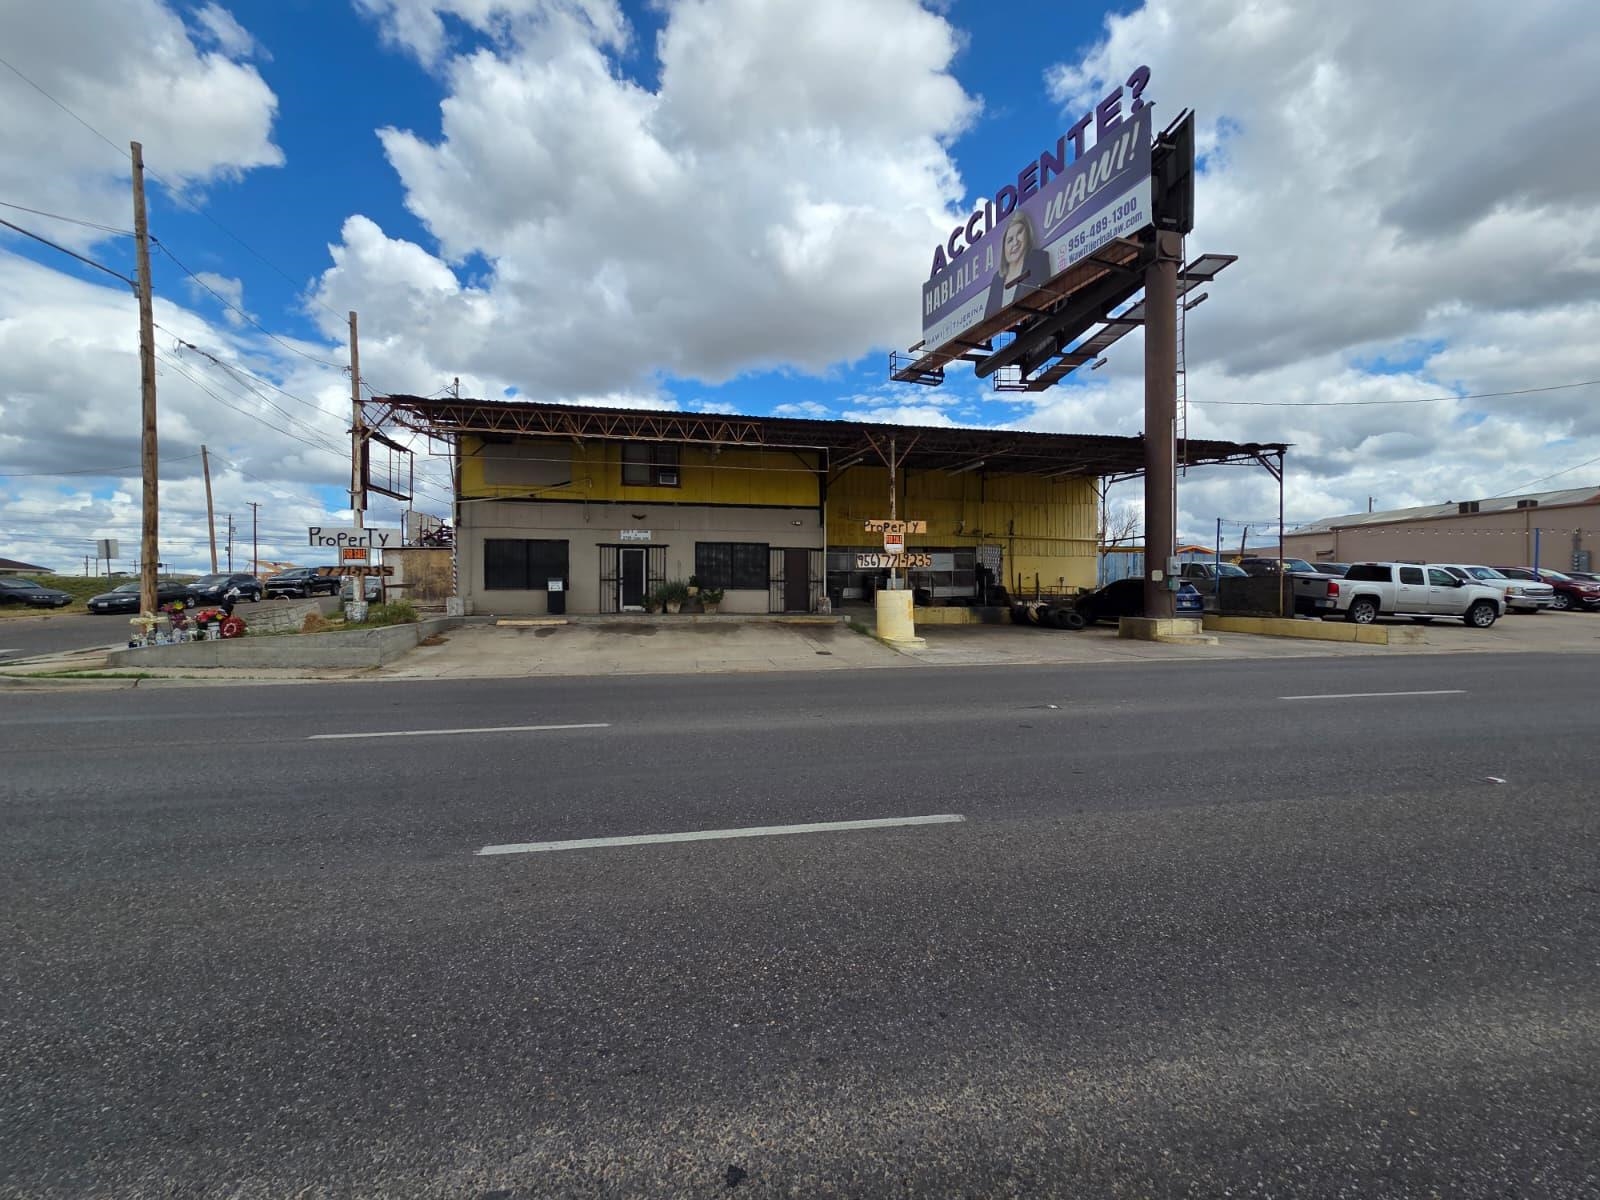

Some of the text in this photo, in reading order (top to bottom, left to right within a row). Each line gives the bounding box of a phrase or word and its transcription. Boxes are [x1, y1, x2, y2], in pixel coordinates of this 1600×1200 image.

[929, 64, 1152, 279] ACCIDENTE?
[1043, 121, 1142, 229] WAWI!
[1068, 196, 1138, 252] 956-489-1300
[925, 243, 994, 316] HABLALE A
